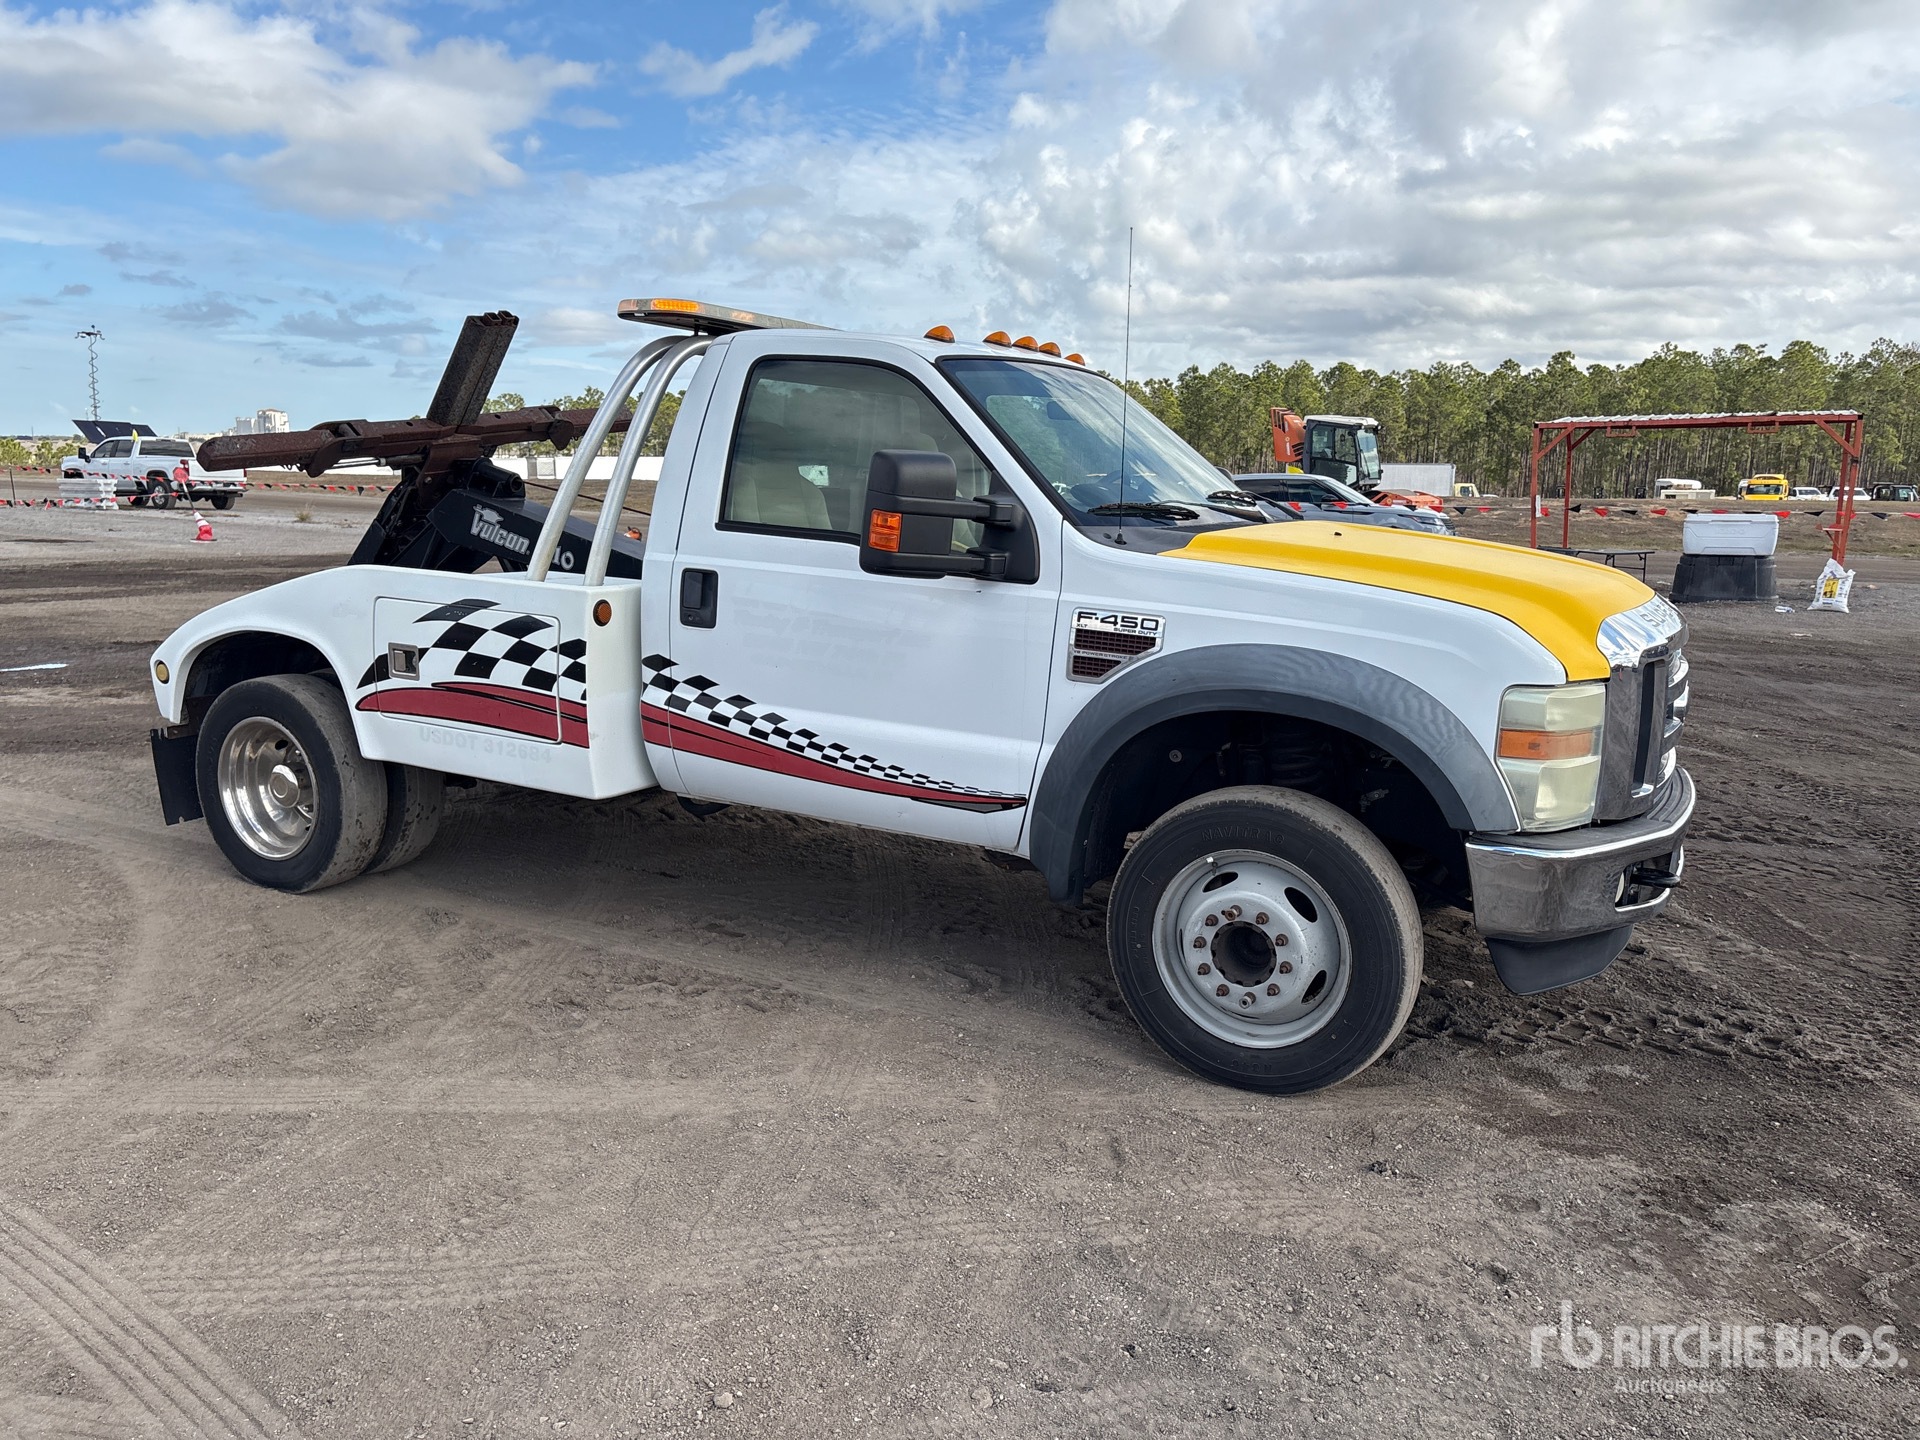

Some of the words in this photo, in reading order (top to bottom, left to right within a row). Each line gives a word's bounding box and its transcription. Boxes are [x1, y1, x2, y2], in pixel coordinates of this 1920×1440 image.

[1076, 611, 1160, 631] F-450
[419, 725, 480, 751] USDOT
[484, 737, 552, 764] 312684
